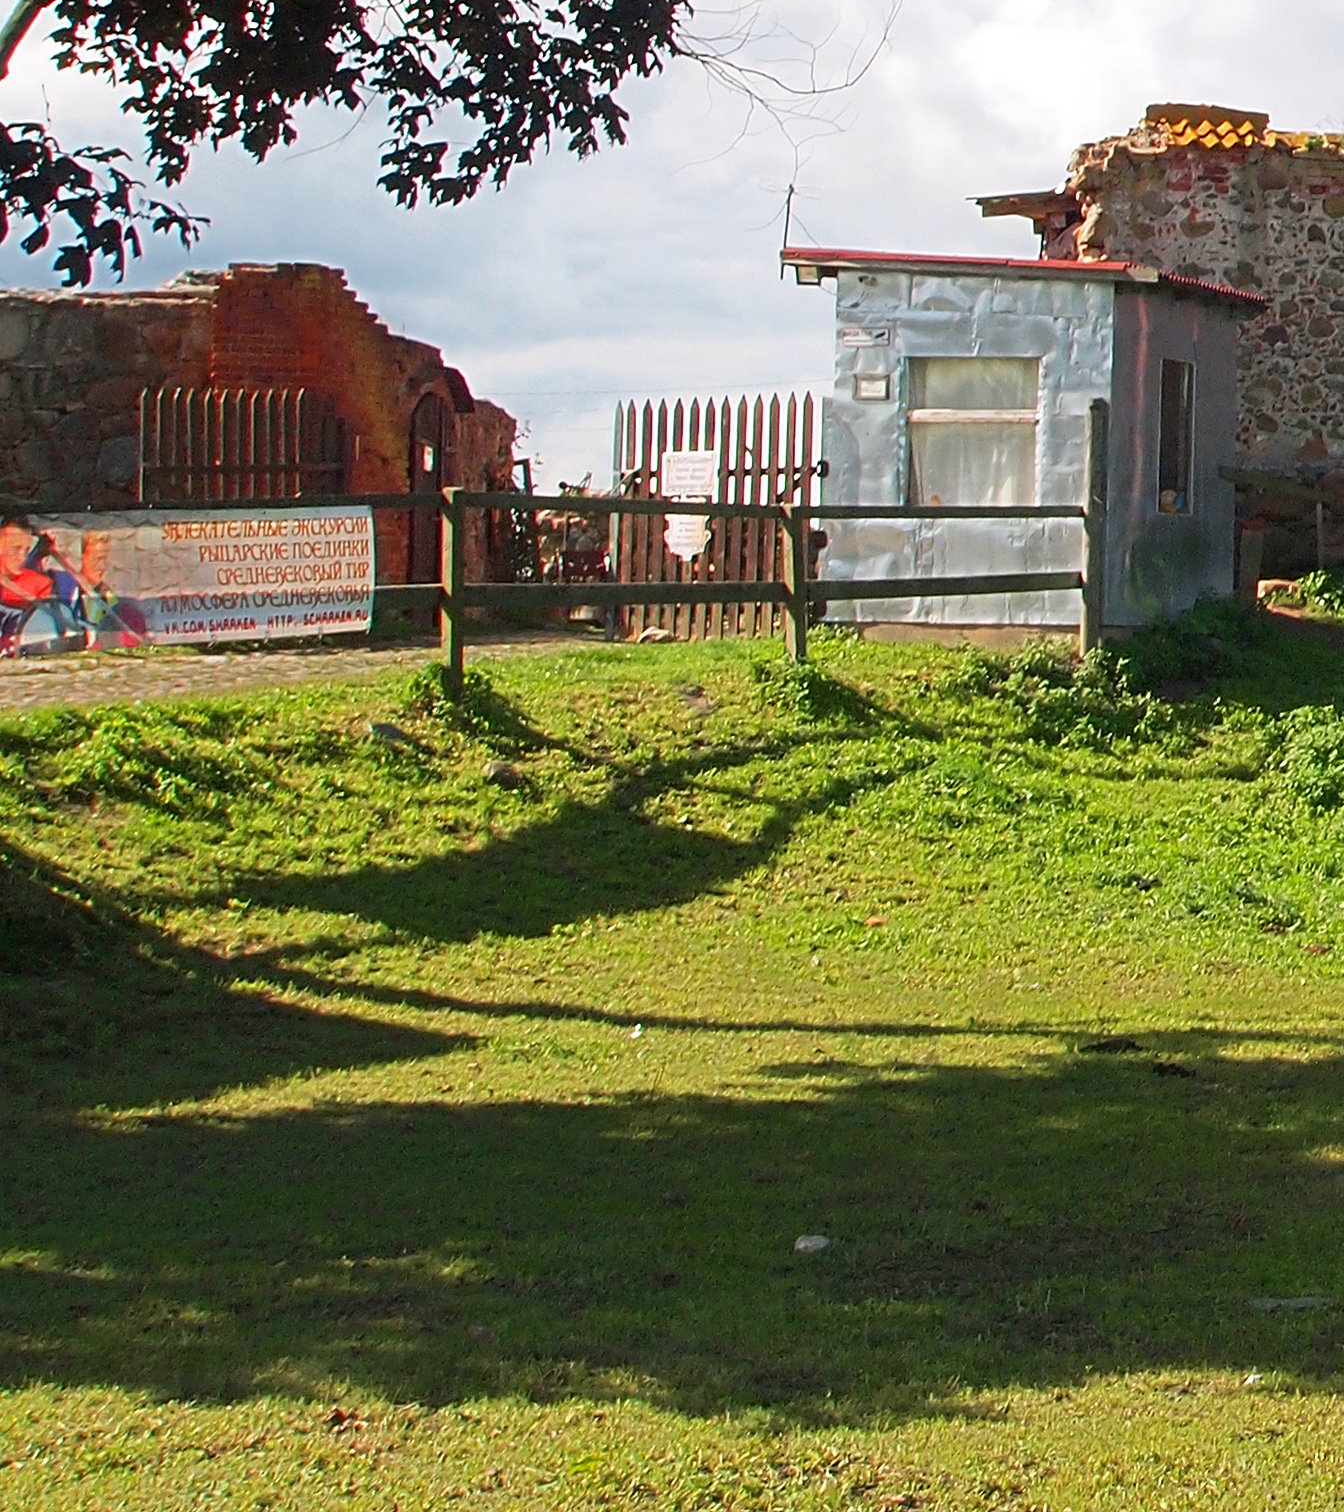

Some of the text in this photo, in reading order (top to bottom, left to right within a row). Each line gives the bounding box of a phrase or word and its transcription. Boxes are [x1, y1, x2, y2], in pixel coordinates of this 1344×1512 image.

[291, 517, 368, 538] ЭКСКУРСИИ
[199, 539, 369, 563] РЫЦАРСКИЕ ПОЕДИНКИ
[217, 561, 370, 587] СРЕДНЕВЕКОВЫЙ ТИР
[160, 584, 370, 614] АТМОСФЕРА СРЕДНЕВЕКОВЬЯ
